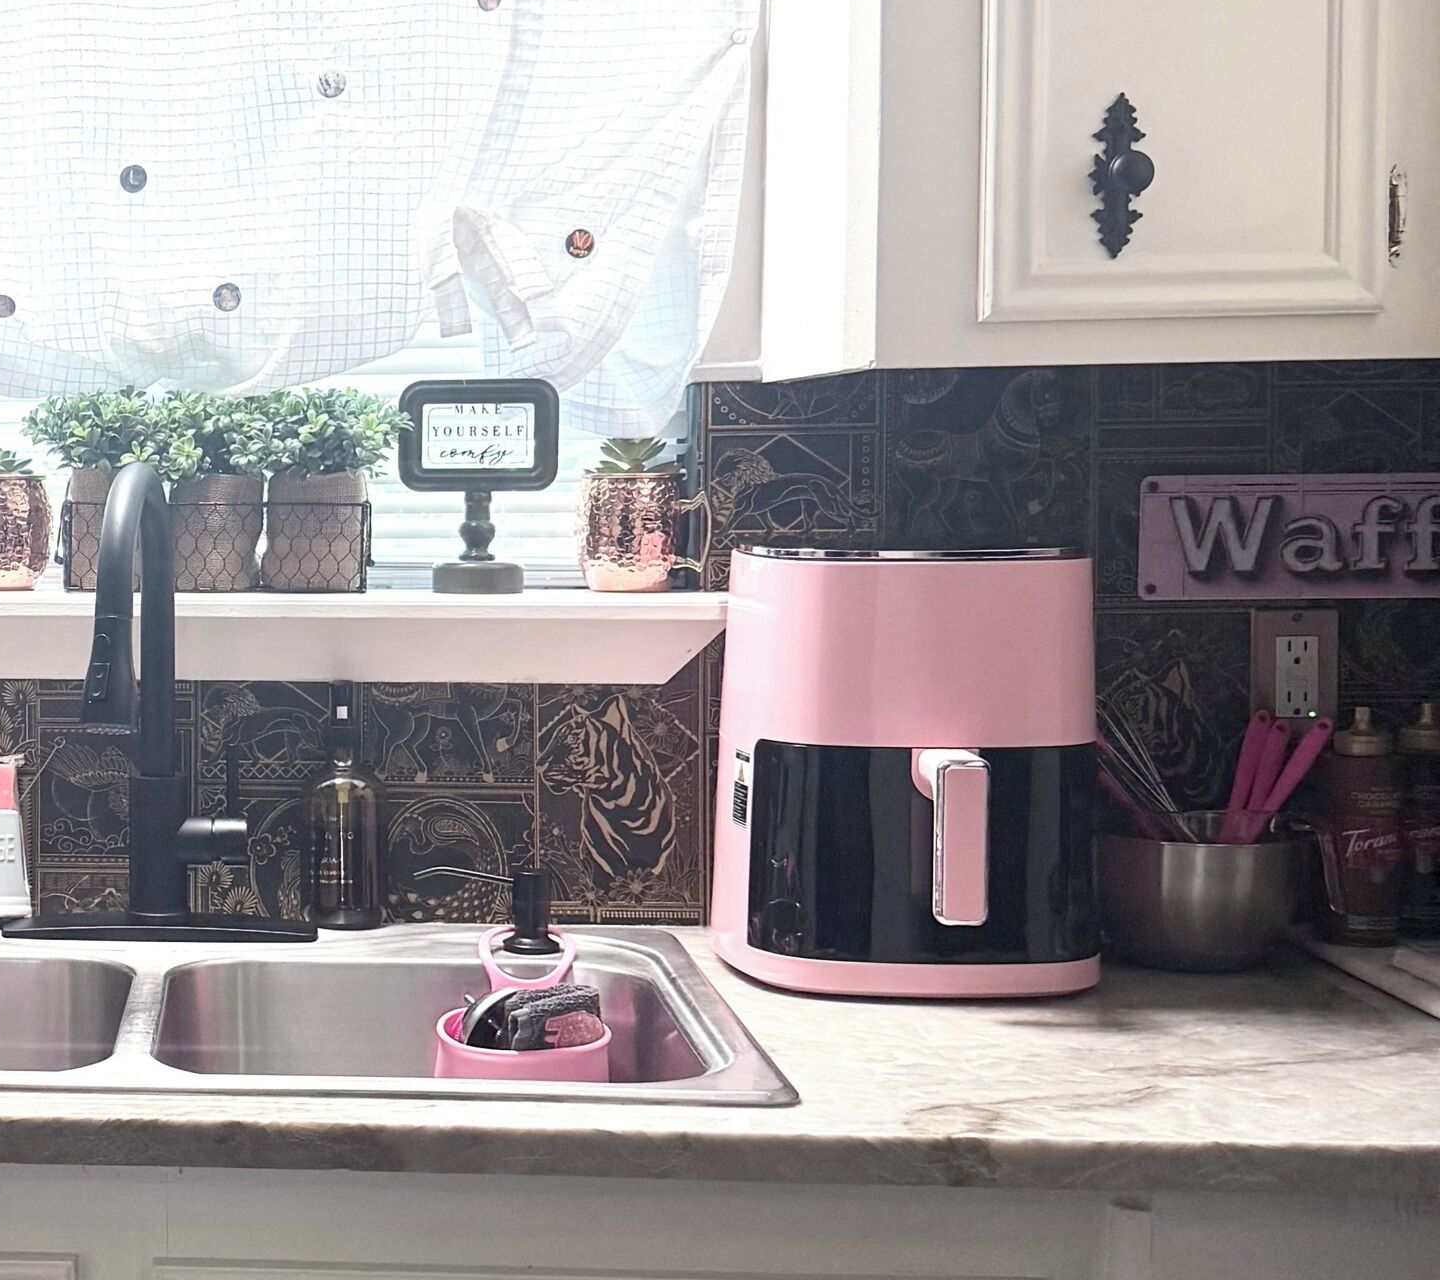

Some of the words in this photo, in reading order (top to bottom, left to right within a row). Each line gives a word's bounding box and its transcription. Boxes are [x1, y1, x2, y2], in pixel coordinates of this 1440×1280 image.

[454, 404, 502, 415] MAKE
[432, 425, 525, 437] YOURSELF
[440, 443, 514, 466] comfy
